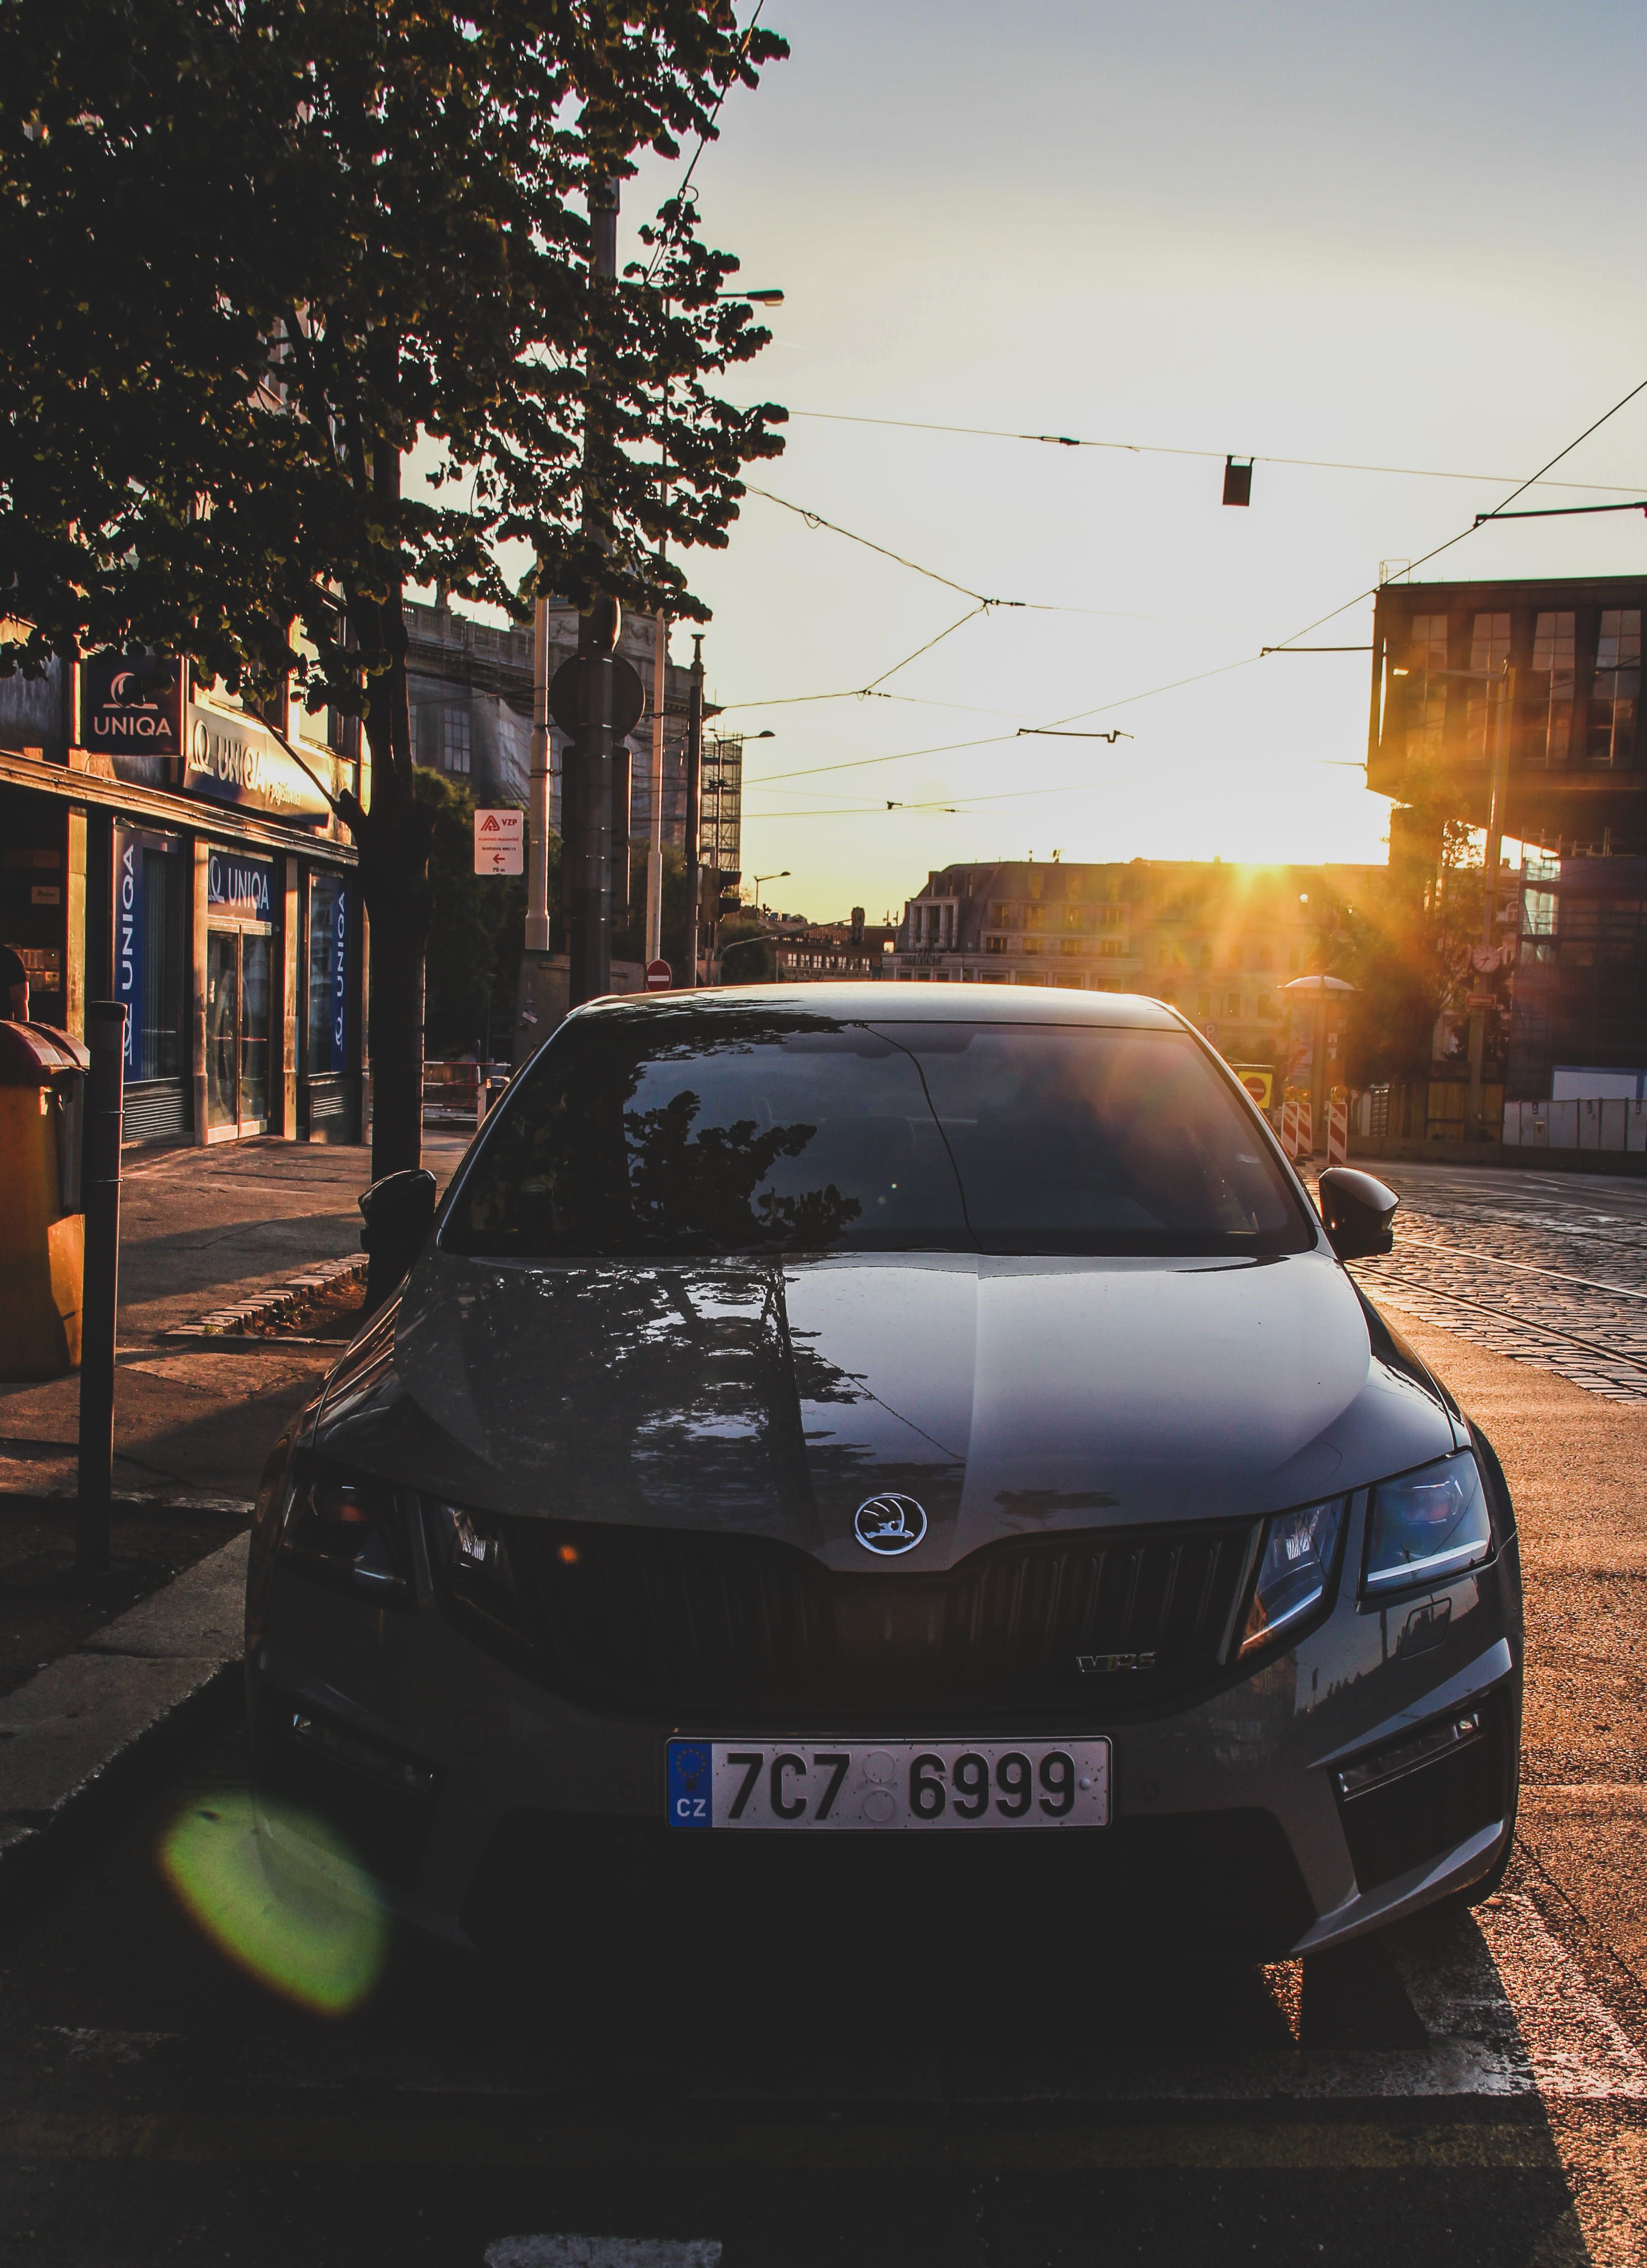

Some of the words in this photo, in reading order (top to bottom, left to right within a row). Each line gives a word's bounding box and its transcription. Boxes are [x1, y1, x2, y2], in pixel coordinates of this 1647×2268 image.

[94, 716, 172, 736] UNIQA
[217, 736, 265, 793] UNIQA
[502, 818, 518, 826] VZP
[122, 844, 134, 990] UNIQA
[228, 867, 269, 910] UNIQA
[337, 892, 345, 997] UNIQA
[676, 1798, 707, 1817] CZ
[727, 1752, 851, 1821] 7C7
[910, 1751, 1076, 1819] 6999
